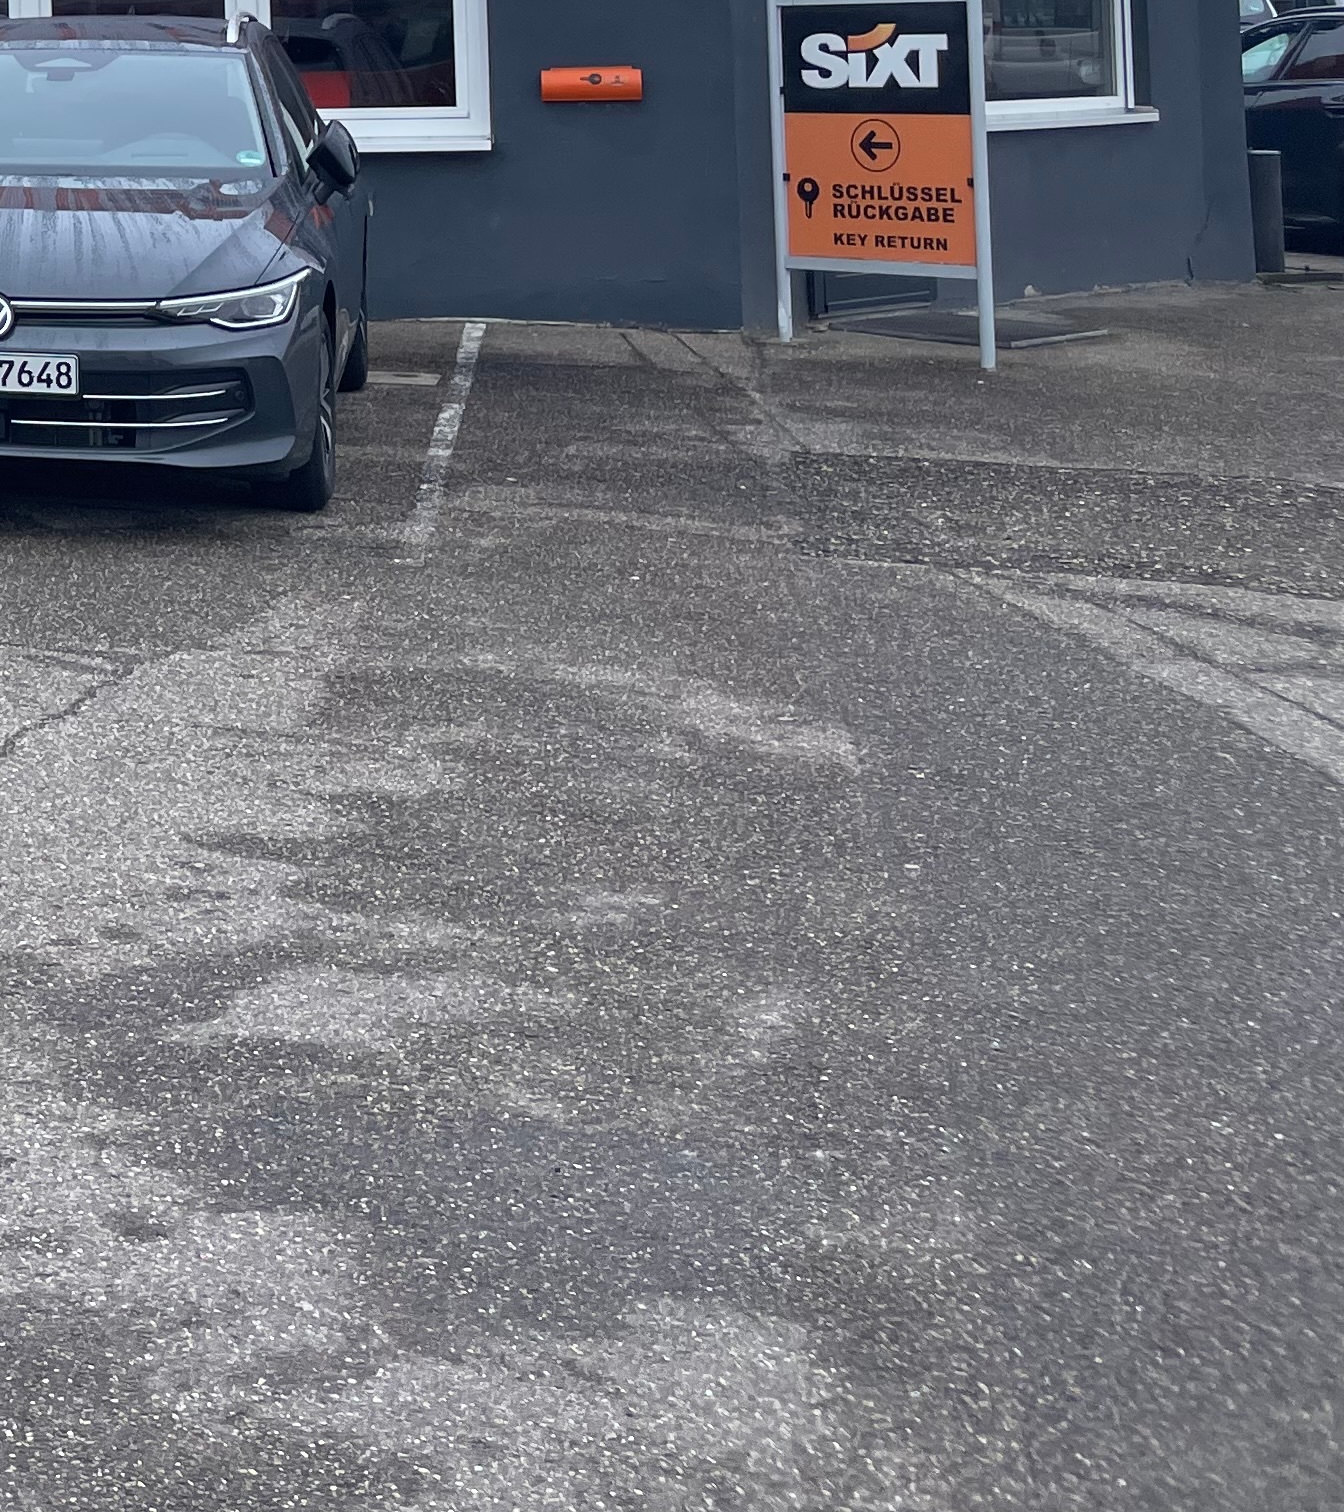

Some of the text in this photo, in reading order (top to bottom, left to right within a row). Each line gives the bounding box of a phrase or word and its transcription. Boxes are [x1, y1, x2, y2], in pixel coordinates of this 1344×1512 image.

[831, 182, 963, 204] SCHLÜSSEL
[832, 200, 955, 223] RÜCKGABE
[833, 232, 948, 251] KEY RETURN
